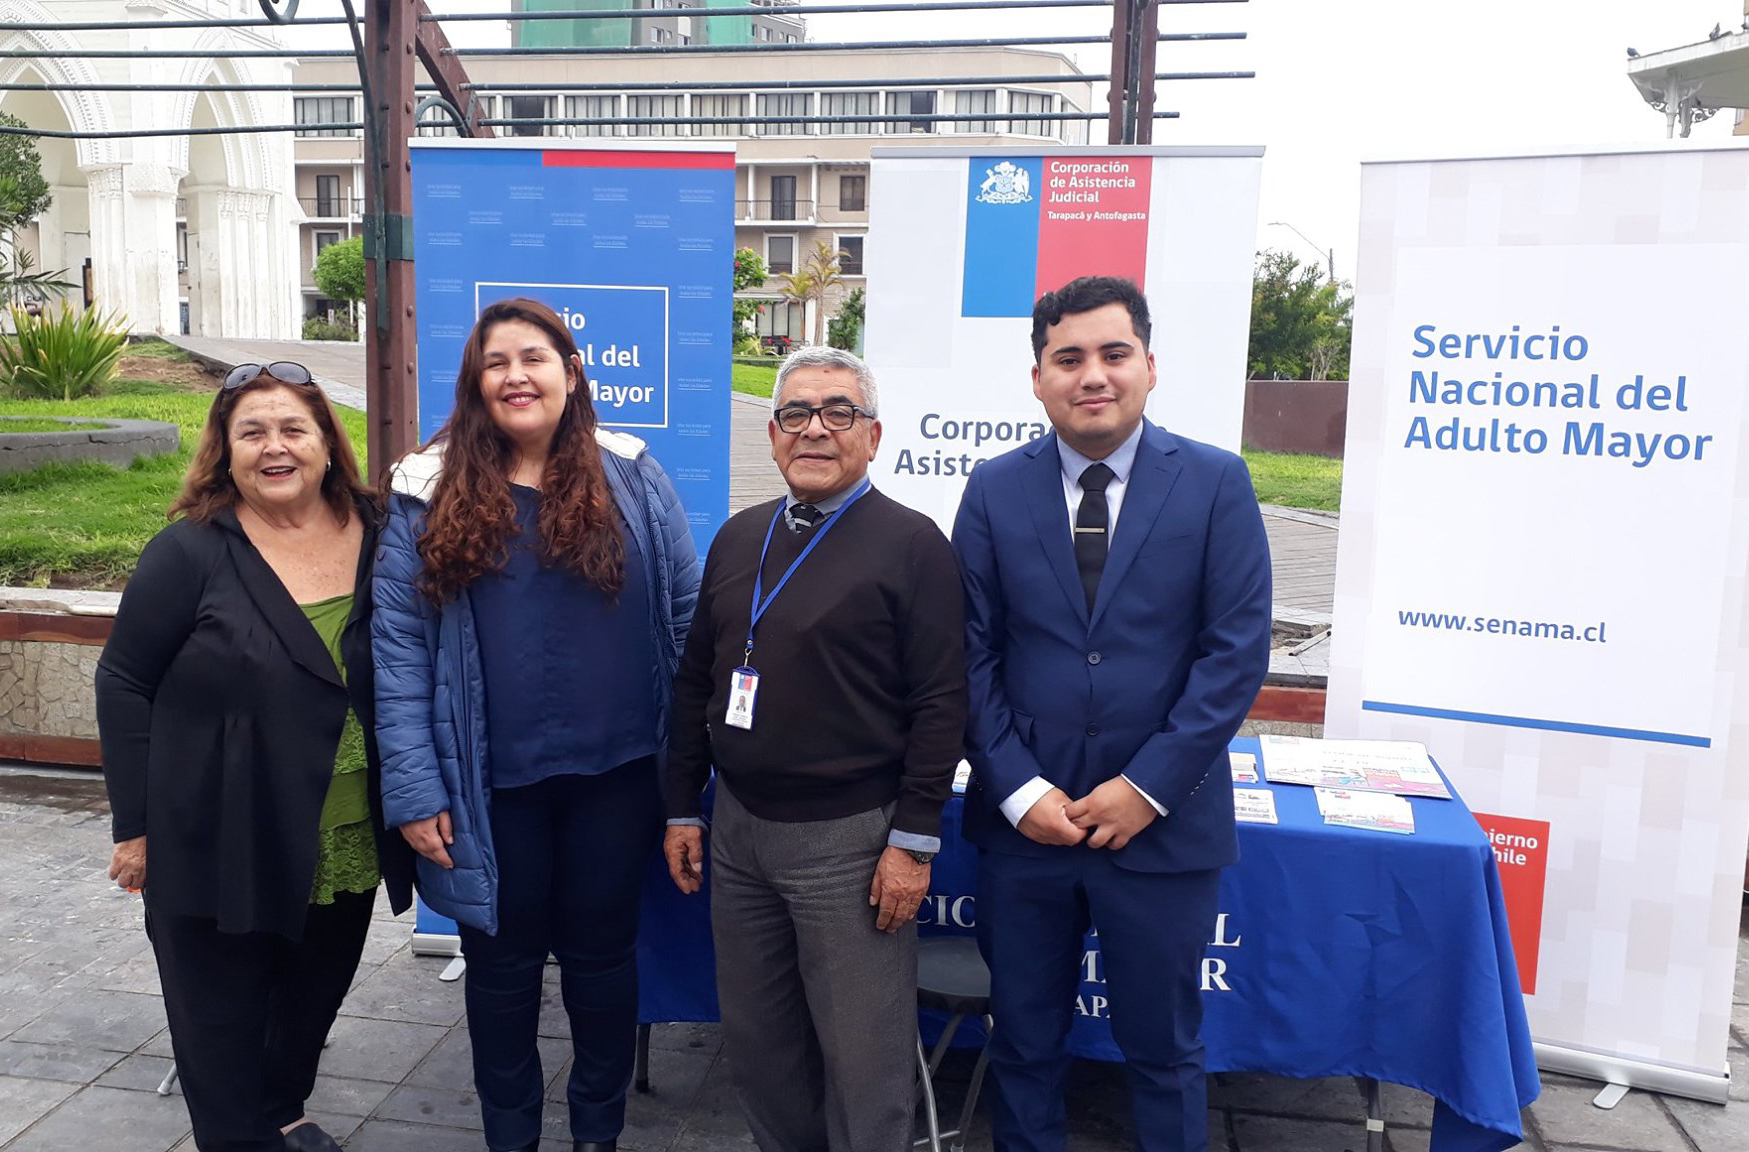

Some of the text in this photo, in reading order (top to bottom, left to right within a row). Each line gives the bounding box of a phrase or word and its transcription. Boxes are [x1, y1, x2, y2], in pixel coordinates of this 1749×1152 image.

[1051, 161, 1129, 175] Corporación
[1050, 176, 1136, 188] de Asistencia
[1049, 191, 1099, 203] Judicial
[1047, 211, 1146, 222] Tarapacá y Antofagasta
[1412, 324, 1589, 361] Servicio
[601, 344, 640, 367] del
[1409, 370, 1689, 412] Nacional del
[920, 413, 1053, 447] Corpora
[1403, 415, 1714, 468] Adulto Mayor
[894, 449, 988, 477] Asist
[1398, 610, 1608, 644] www.senama.cl
[1484, 828, 1538, 849] ierno
[1492, 846, 1527, 866] hile
